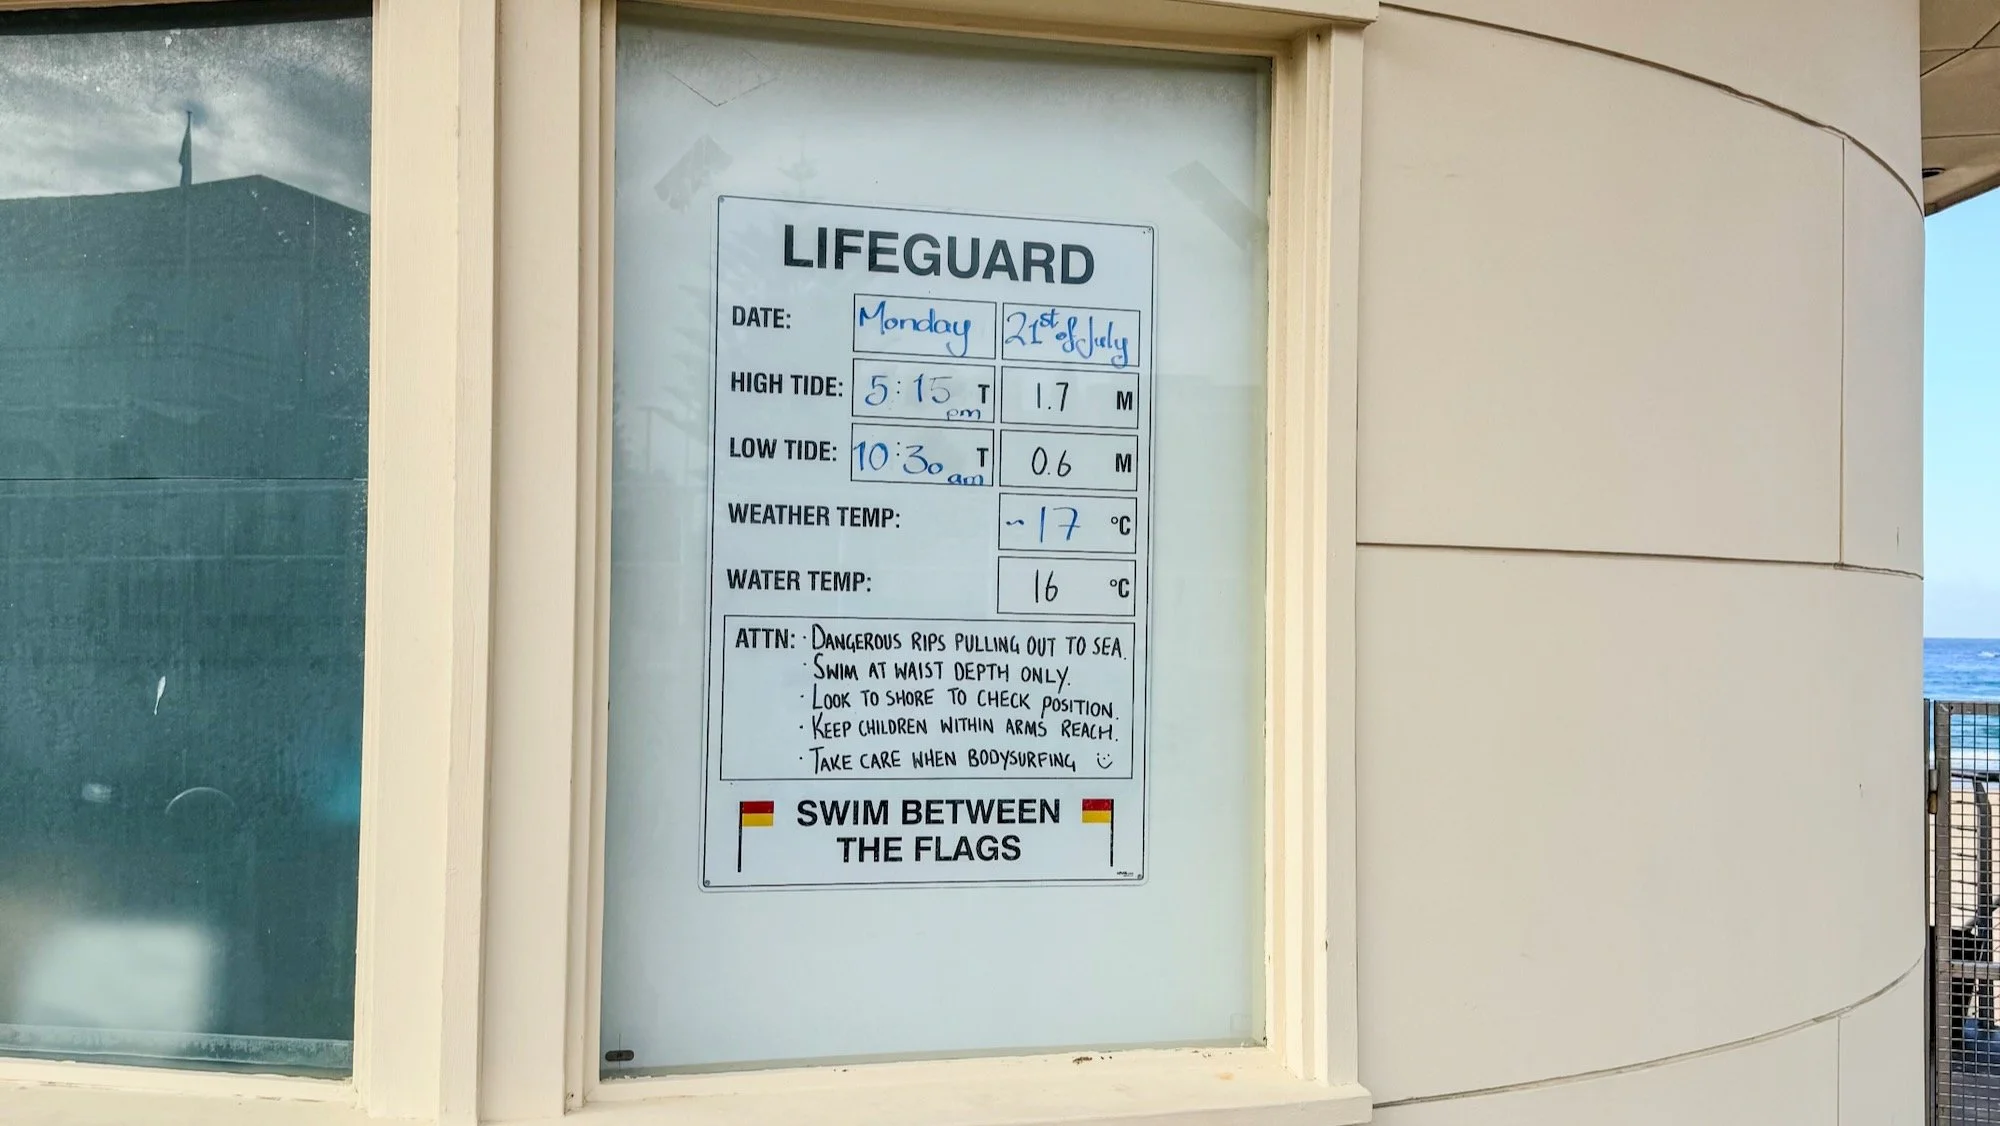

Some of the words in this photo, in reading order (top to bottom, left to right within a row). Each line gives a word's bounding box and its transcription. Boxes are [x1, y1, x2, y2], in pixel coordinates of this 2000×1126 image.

[784, 224, 1095, 285] LIFEGUARD
[732, 305, 791, 329] DATE:
[859, 301, 971, 357] Monday
[1075, 315, 1129, 369] July
[730, 372, 783, 394] HIGH
[790, 374, 843, 397] TIDE:
[978, 385, 990, 404] T
[1036, 382, 1069, 411] 1.7
[1116, 390, 1133, 410] M
[946, 407, 981, 421] pm
[729, 437, 778, 460] LOW
[784, 439, 837, 462] TIDE:
[976, 448, 989, 467] T
[1031, 447, 1072, 477] 0.6
[1115, 453, 1132, 472] M
[947, 472, 985, 486] am
[728, 503, 830, 526] WEATHER
[836, 506, 900, 528] TEMP:
[1110, 516, 1131, 536] °C
[726, 569, 801, 590] WATER
[808, 571, 872, 592] TEMP:
[1035, 570, 1058, 603] 16
[1109, 578, 1130, 598] °C
[735, 628, 795, 649] ATTN:
[811, 624, 902, 651] DANGEROUS
[911, 631, 946, 653] RIPS
[954, 633, 1020, 654] PULLING
[1026, 636, 1058, 656] OUT
[1065, 637, 1087, 656] TO
[1092, 636, 1127, 660] SEA.
[813, 654, 859, 680] SWIM
[868, 662, 887, 680] AT
[894, 661, 944, 680] WAIST
[954, 664, 1010, 683] DEPTH
[1021, 666, 1072, 694] ONLY.
[811, 683, 851, 709] LOOK
[859, 689, 880, 707] TO
[886, 689, 934, 706] SHORE
[947, 687, 967, 705] TO
[977, 691, 1030, 710] CHECK
[811, 713, 852, 740] KEEP
[859, 718, 928, 736] CHILDREN
[941, 717, 994, 735] WITHIN
[1006, 718, 1048, 738] ARMS
[1061, 722, 1119, 742] REACH.
[809, 747, 853, 775] TAKE
[860, 751, 901, 769] CARE
[912, 749, 957, 768] WHEN
[968, 748, 1076, 771] BODYSURFING
[796, 798, 890, 827] SWIM
[901, 798, 1060, 825] BETWEEN
[837, 836, 903, 863] THE
[914, 835, 1022, 863] FLAGS
